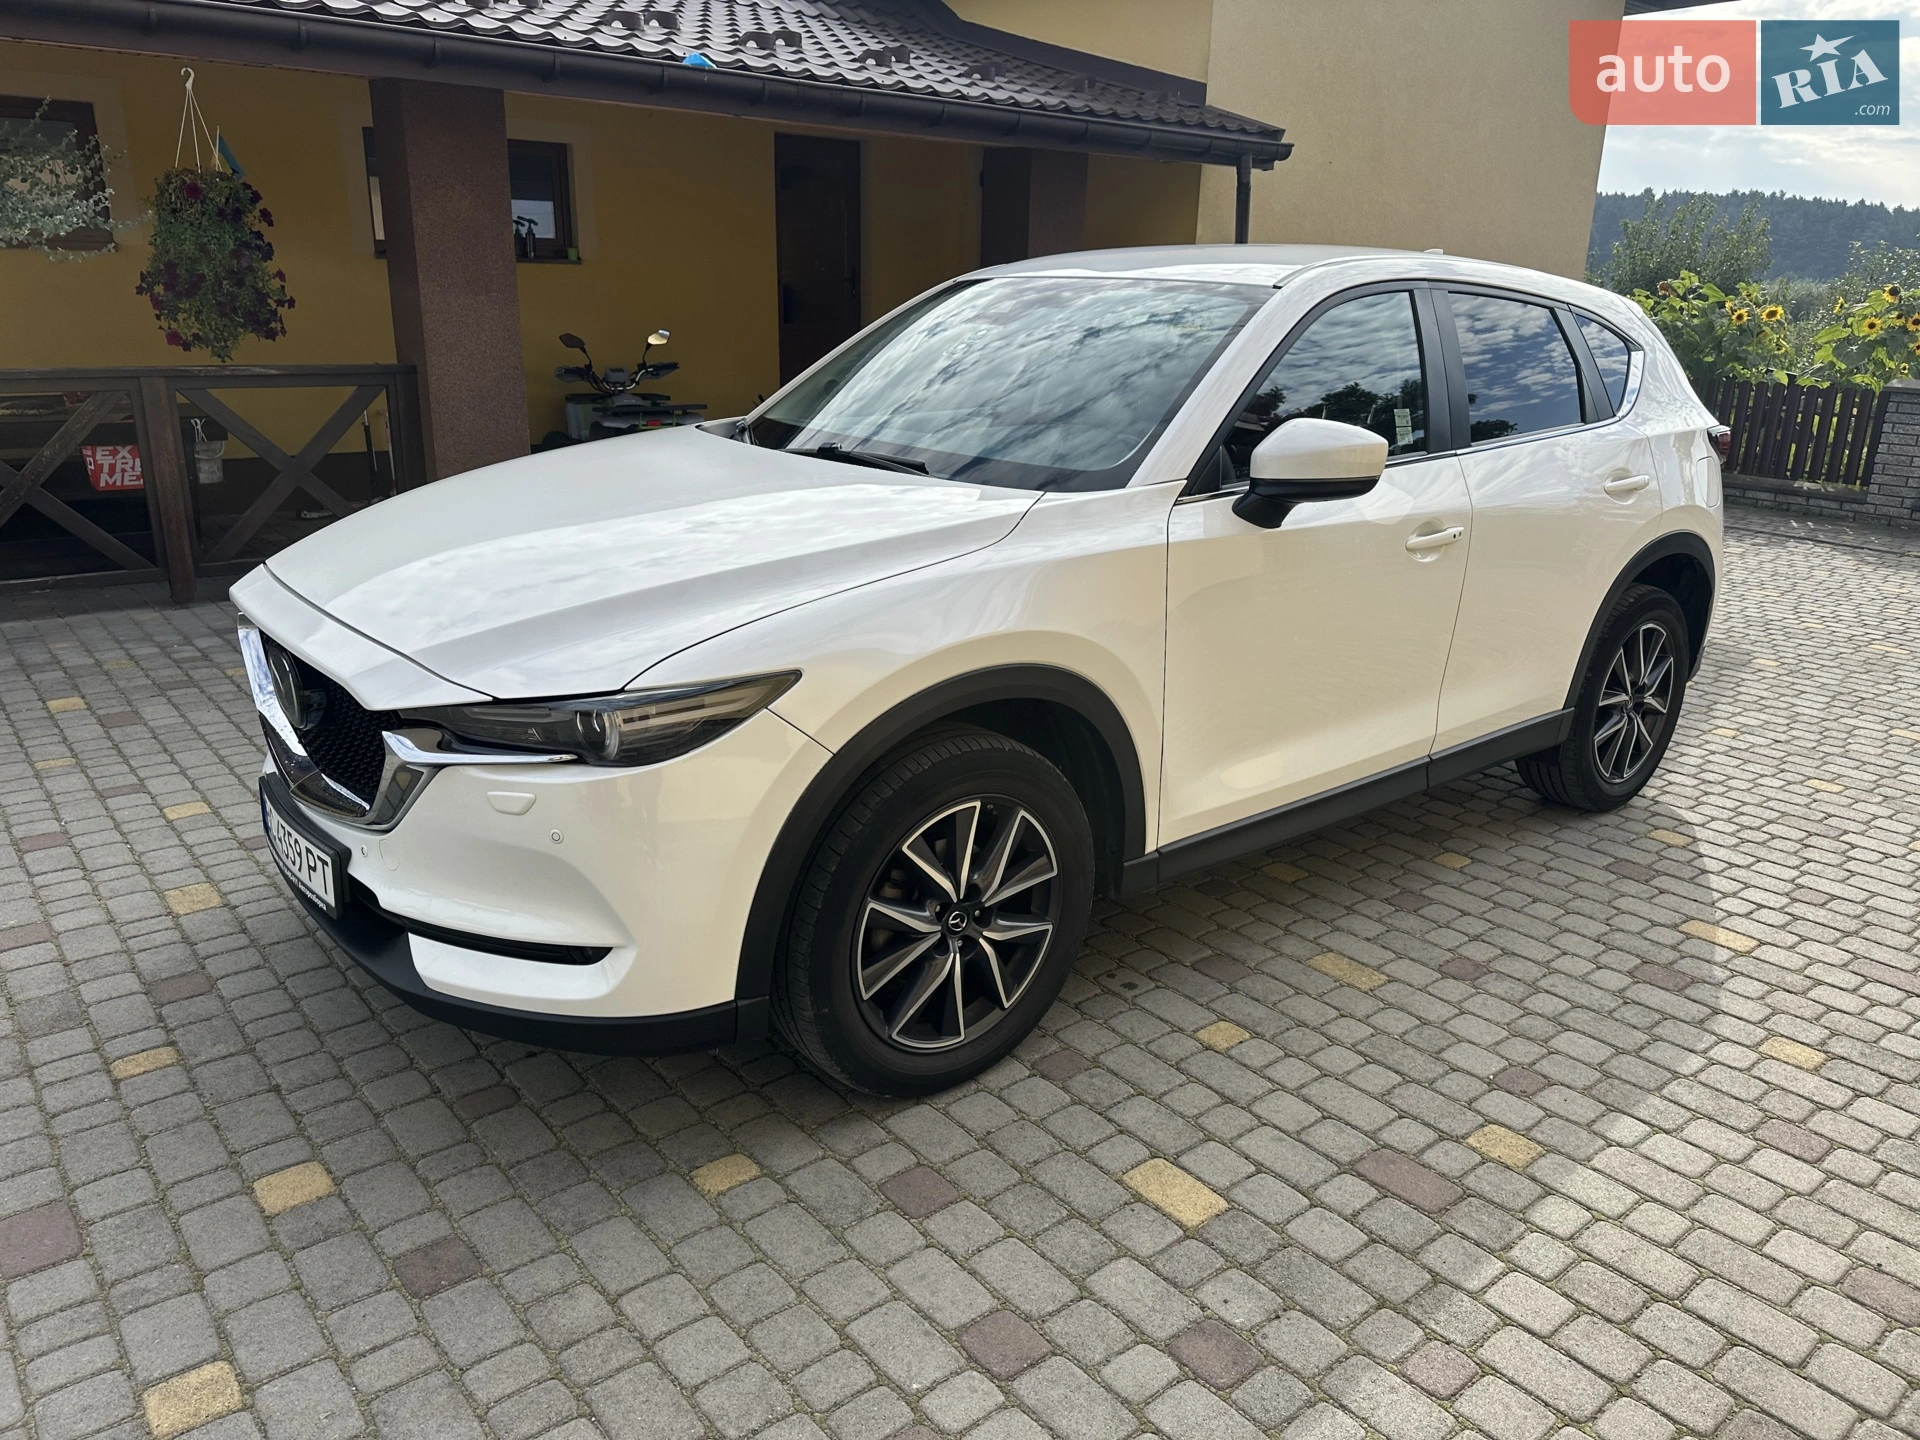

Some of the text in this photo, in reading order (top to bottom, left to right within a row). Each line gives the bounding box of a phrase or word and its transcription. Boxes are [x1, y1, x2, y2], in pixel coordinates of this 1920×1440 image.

[95, 446, 133, 460] EX
[277, 819, 302, 873] 4359
[305, 845, 330, 895] PT
